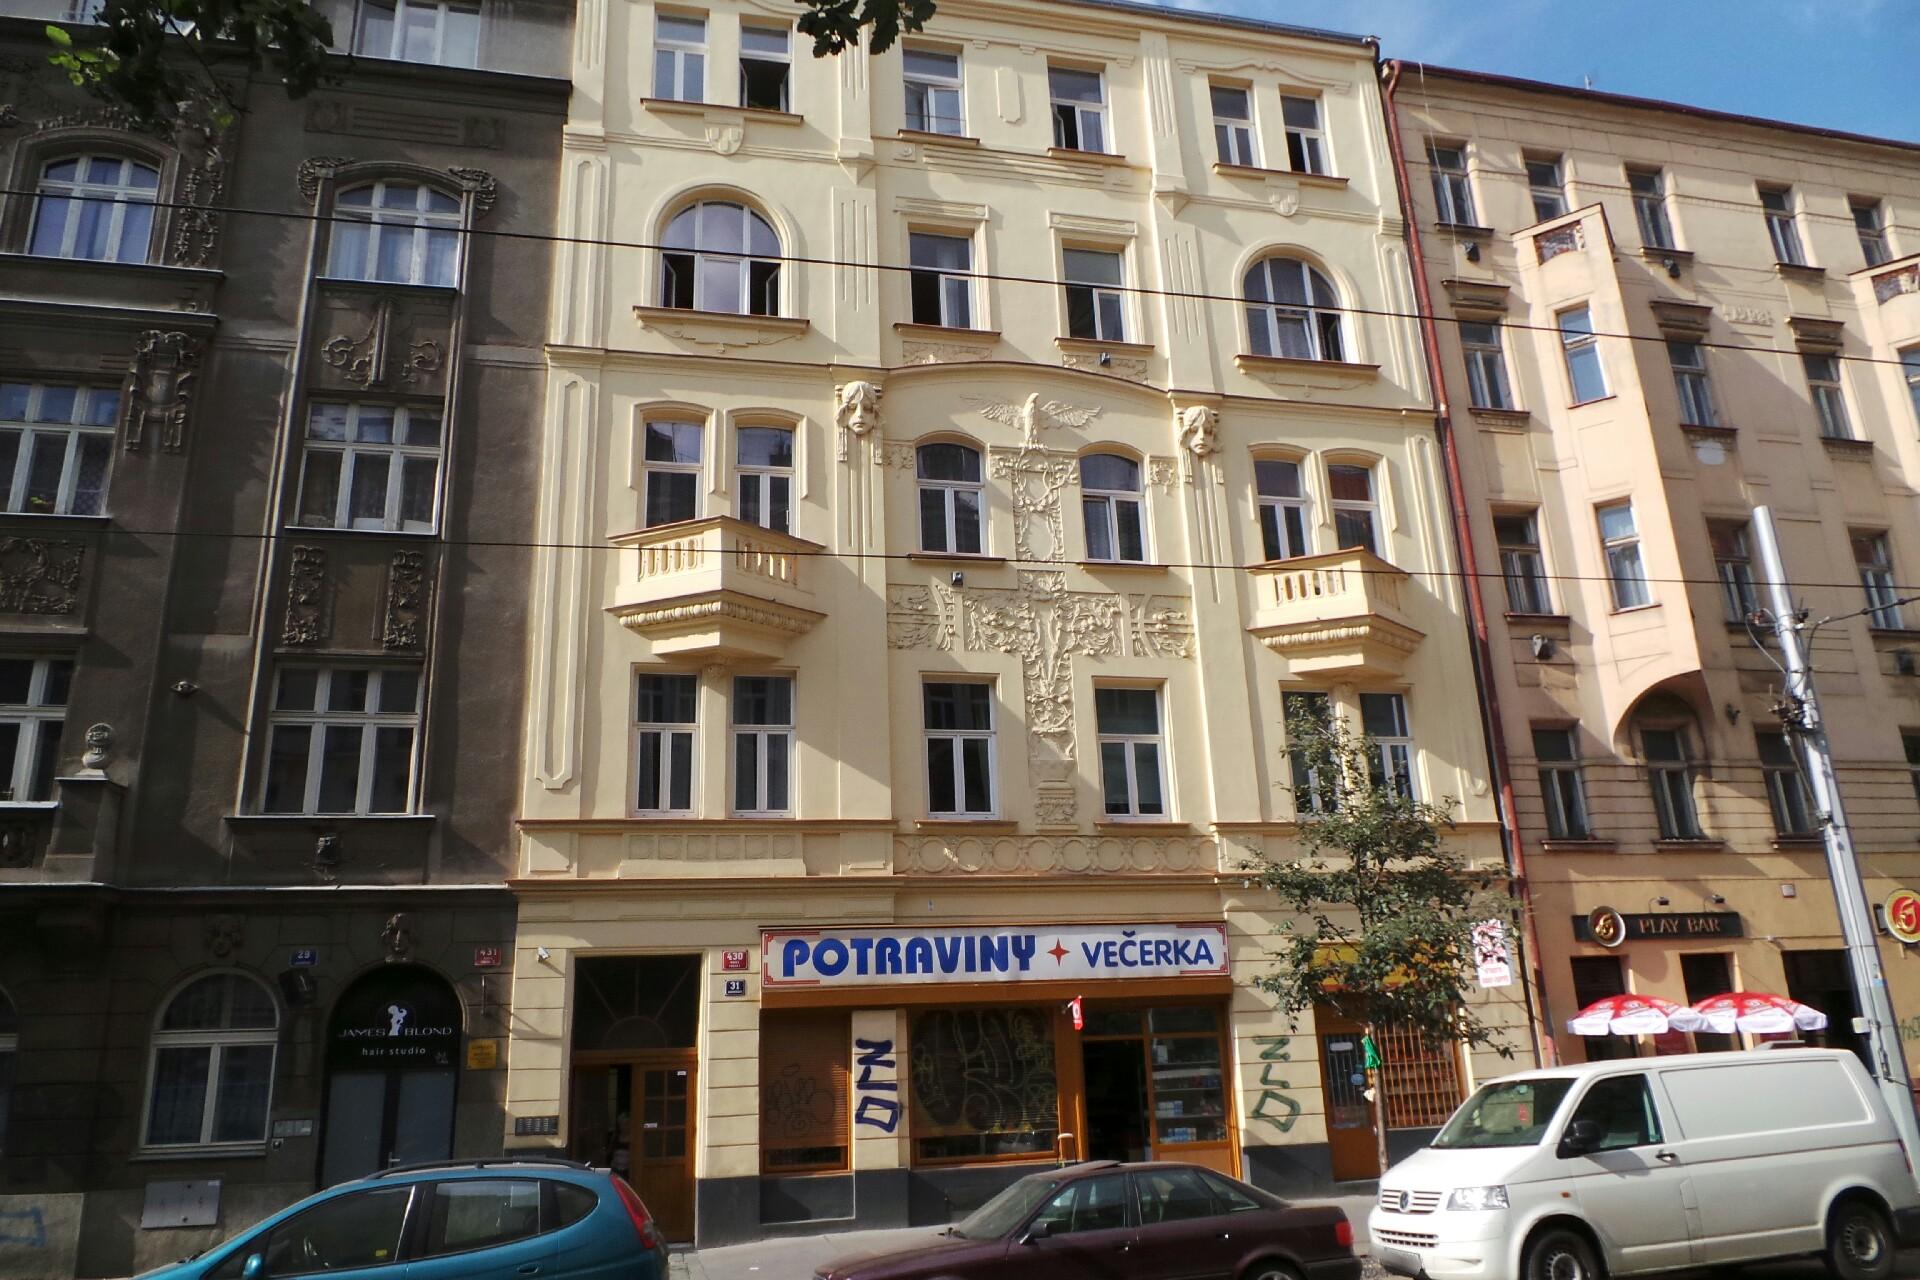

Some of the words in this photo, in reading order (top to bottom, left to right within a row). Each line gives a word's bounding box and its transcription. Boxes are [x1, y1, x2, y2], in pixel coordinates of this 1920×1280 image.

[1639, 918, 1679, 934] PLAY
[1687, 917, 1721, 932] BAR
[297, 950, 311, 959] 29
[726, 952, 744, 961] 430
[783, 935, 1036, 977] POTRAVINY
[1081, 930, 1214, 968] VEČERKA
[729, 981, 740, 990] 31
[339, 1027, 386, 1037] JAMES
[404, 1026, 452, 1036] BLOND
[362, 1047, 385, 1056] hair
[389, 1046, 426, 1056] studio
